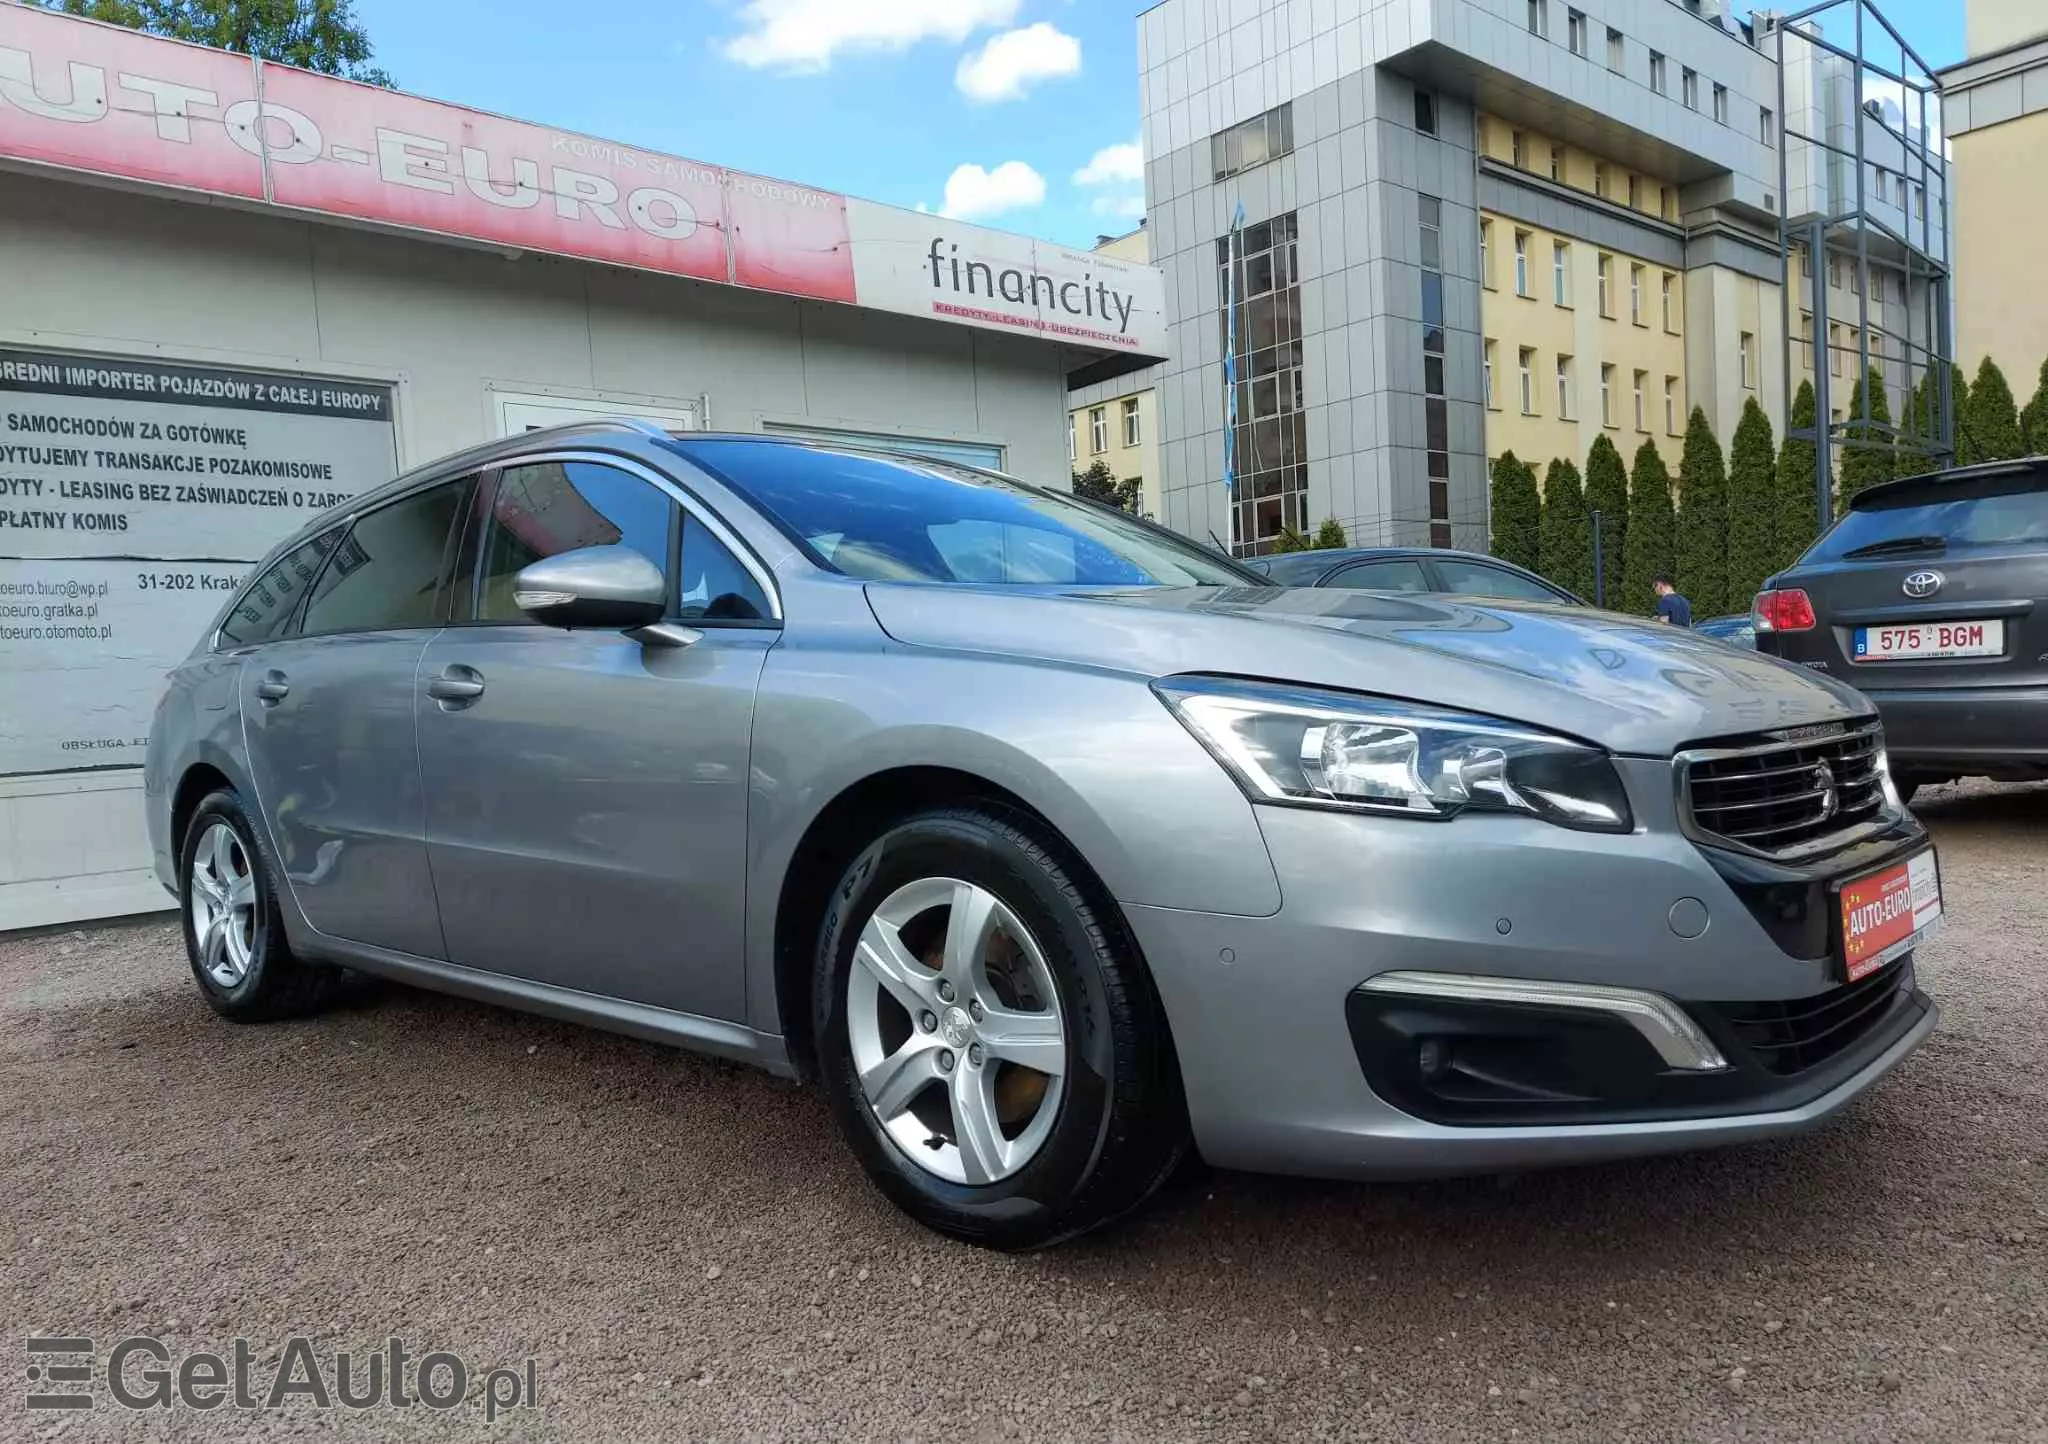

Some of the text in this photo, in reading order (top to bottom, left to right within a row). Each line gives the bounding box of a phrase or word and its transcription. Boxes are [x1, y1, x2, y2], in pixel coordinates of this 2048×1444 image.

[552, 136, 637, 169] KOMIS
[928, 238, 1132, 333] financity
[66, 367, 156, 392] IMPORTER
[160, 375, 250, 400] POJAZDÓW
[254, 384, 265, 401] Z
[269, 385, 317, 406] CAŁEJ
[321, 390, 380, 411] EUROPY
[8, 413, 247, 450] SAMOCHODÓW ZA GOTÓWKĘ
[94, 451, 205, 473] TRANSAKCJE
[209, 458, 333, 480] POZAKOMISOWE
[60, 480, 134, 500] LEASING
[139, 484, 171, 501] BEZ
[176, 482, 288, 507] ZAŚWIADCZEŃ
[293, 491, 303, 508] O
[0, 510, 128, 531] PŁATNY KOMIS
[138, 574, 246, 590] 31-202 Krak
[1880, 625, 1983, 650] 575 BGM
[1850, 887, 1912, 938] AUTO-EURO
